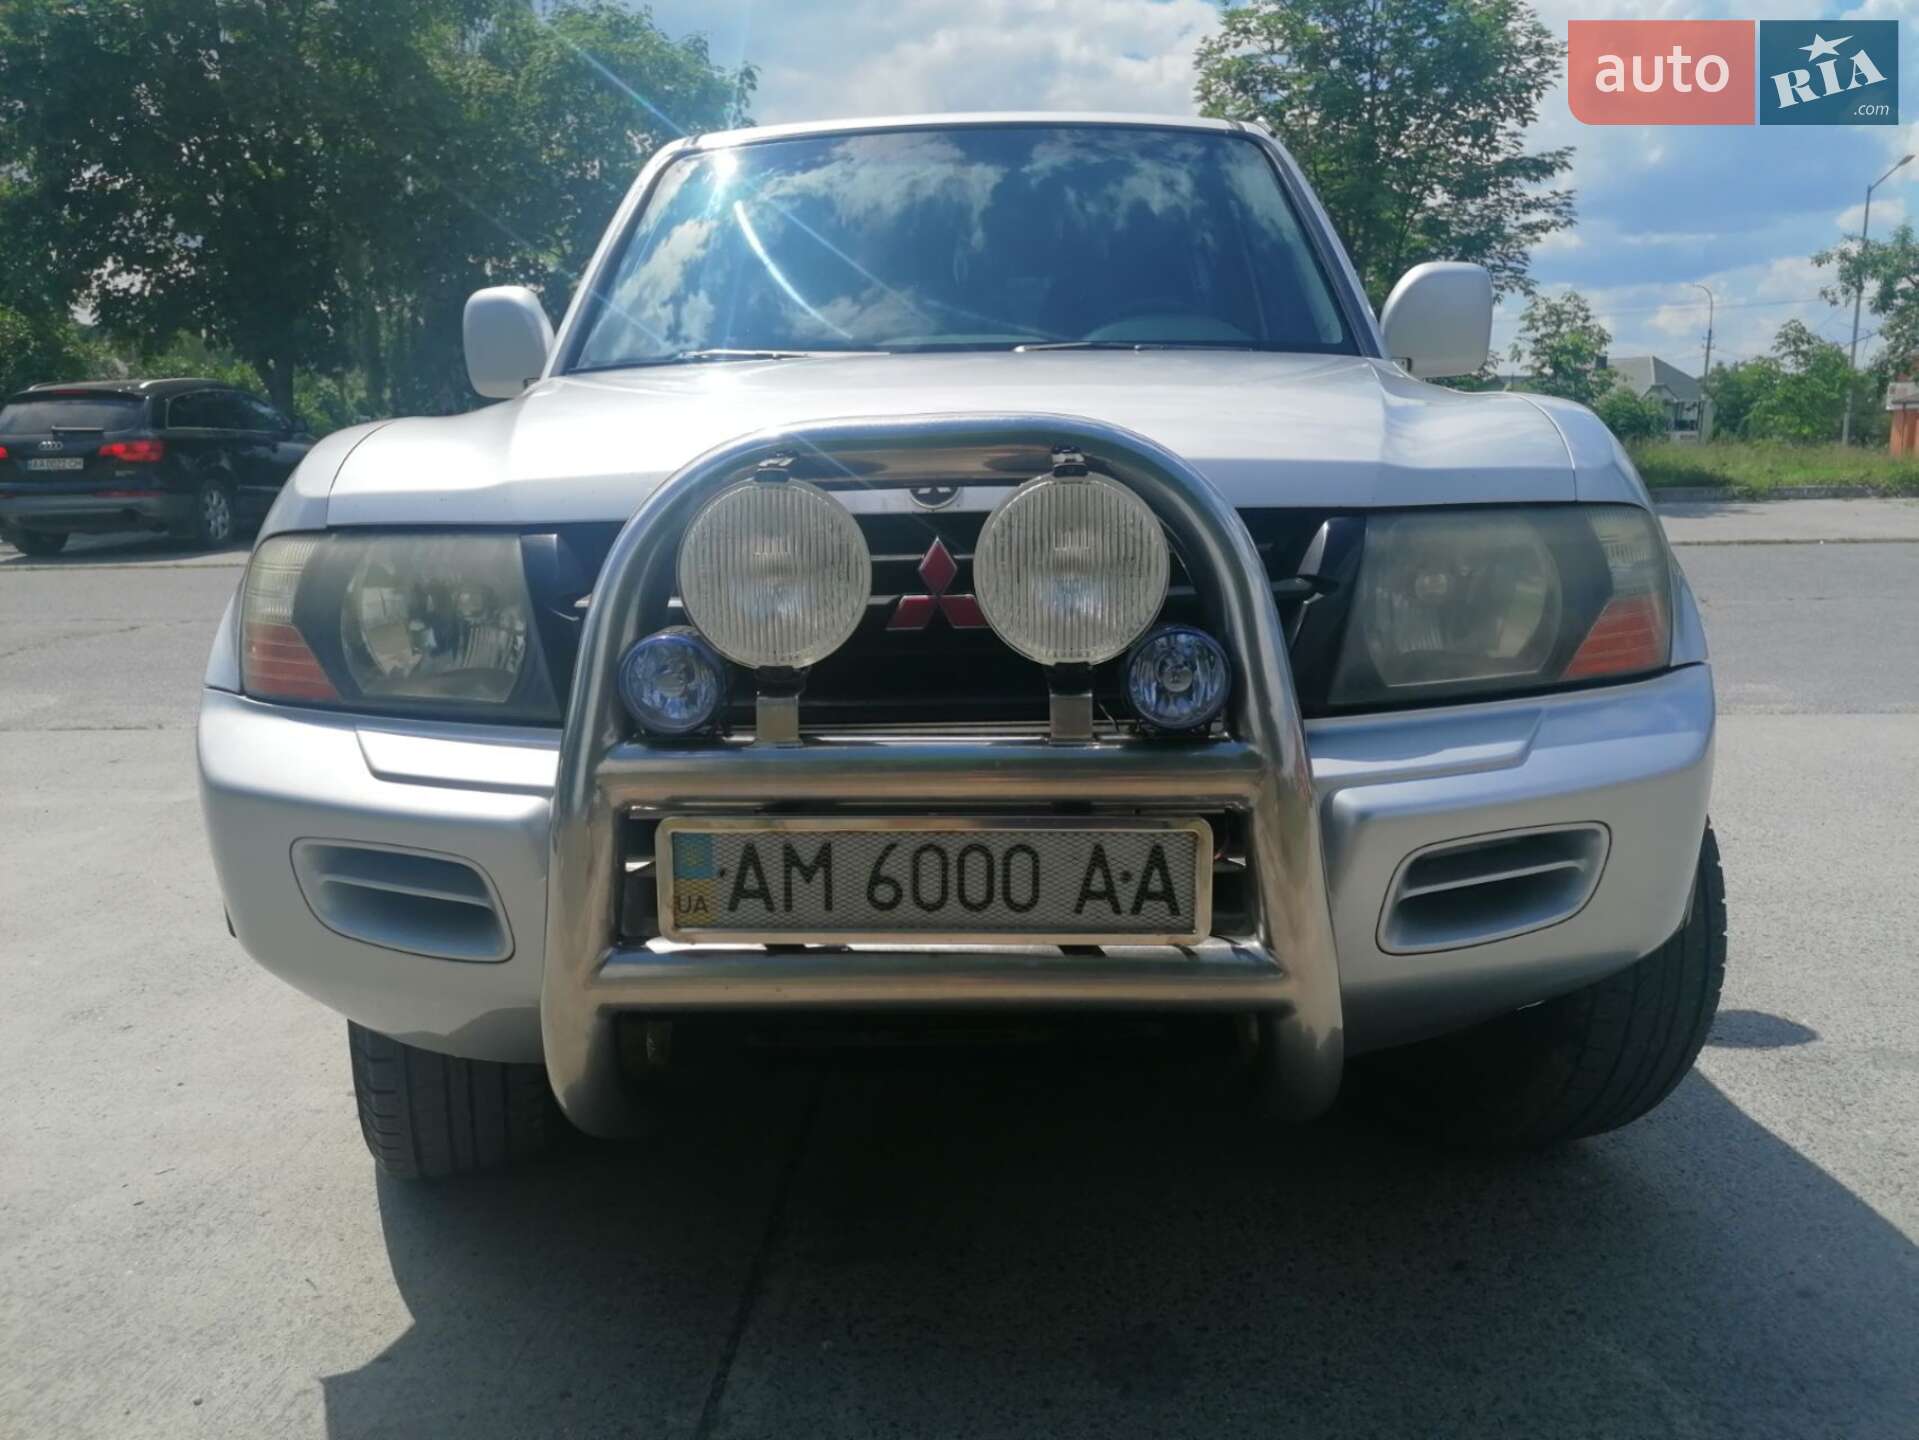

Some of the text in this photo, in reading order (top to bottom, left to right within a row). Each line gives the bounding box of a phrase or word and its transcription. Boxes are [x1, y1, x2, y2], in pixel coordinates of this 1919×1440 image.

[726, 842, 1181, 916] AM 6000 AA
[677, 895, 710, 915] UA
